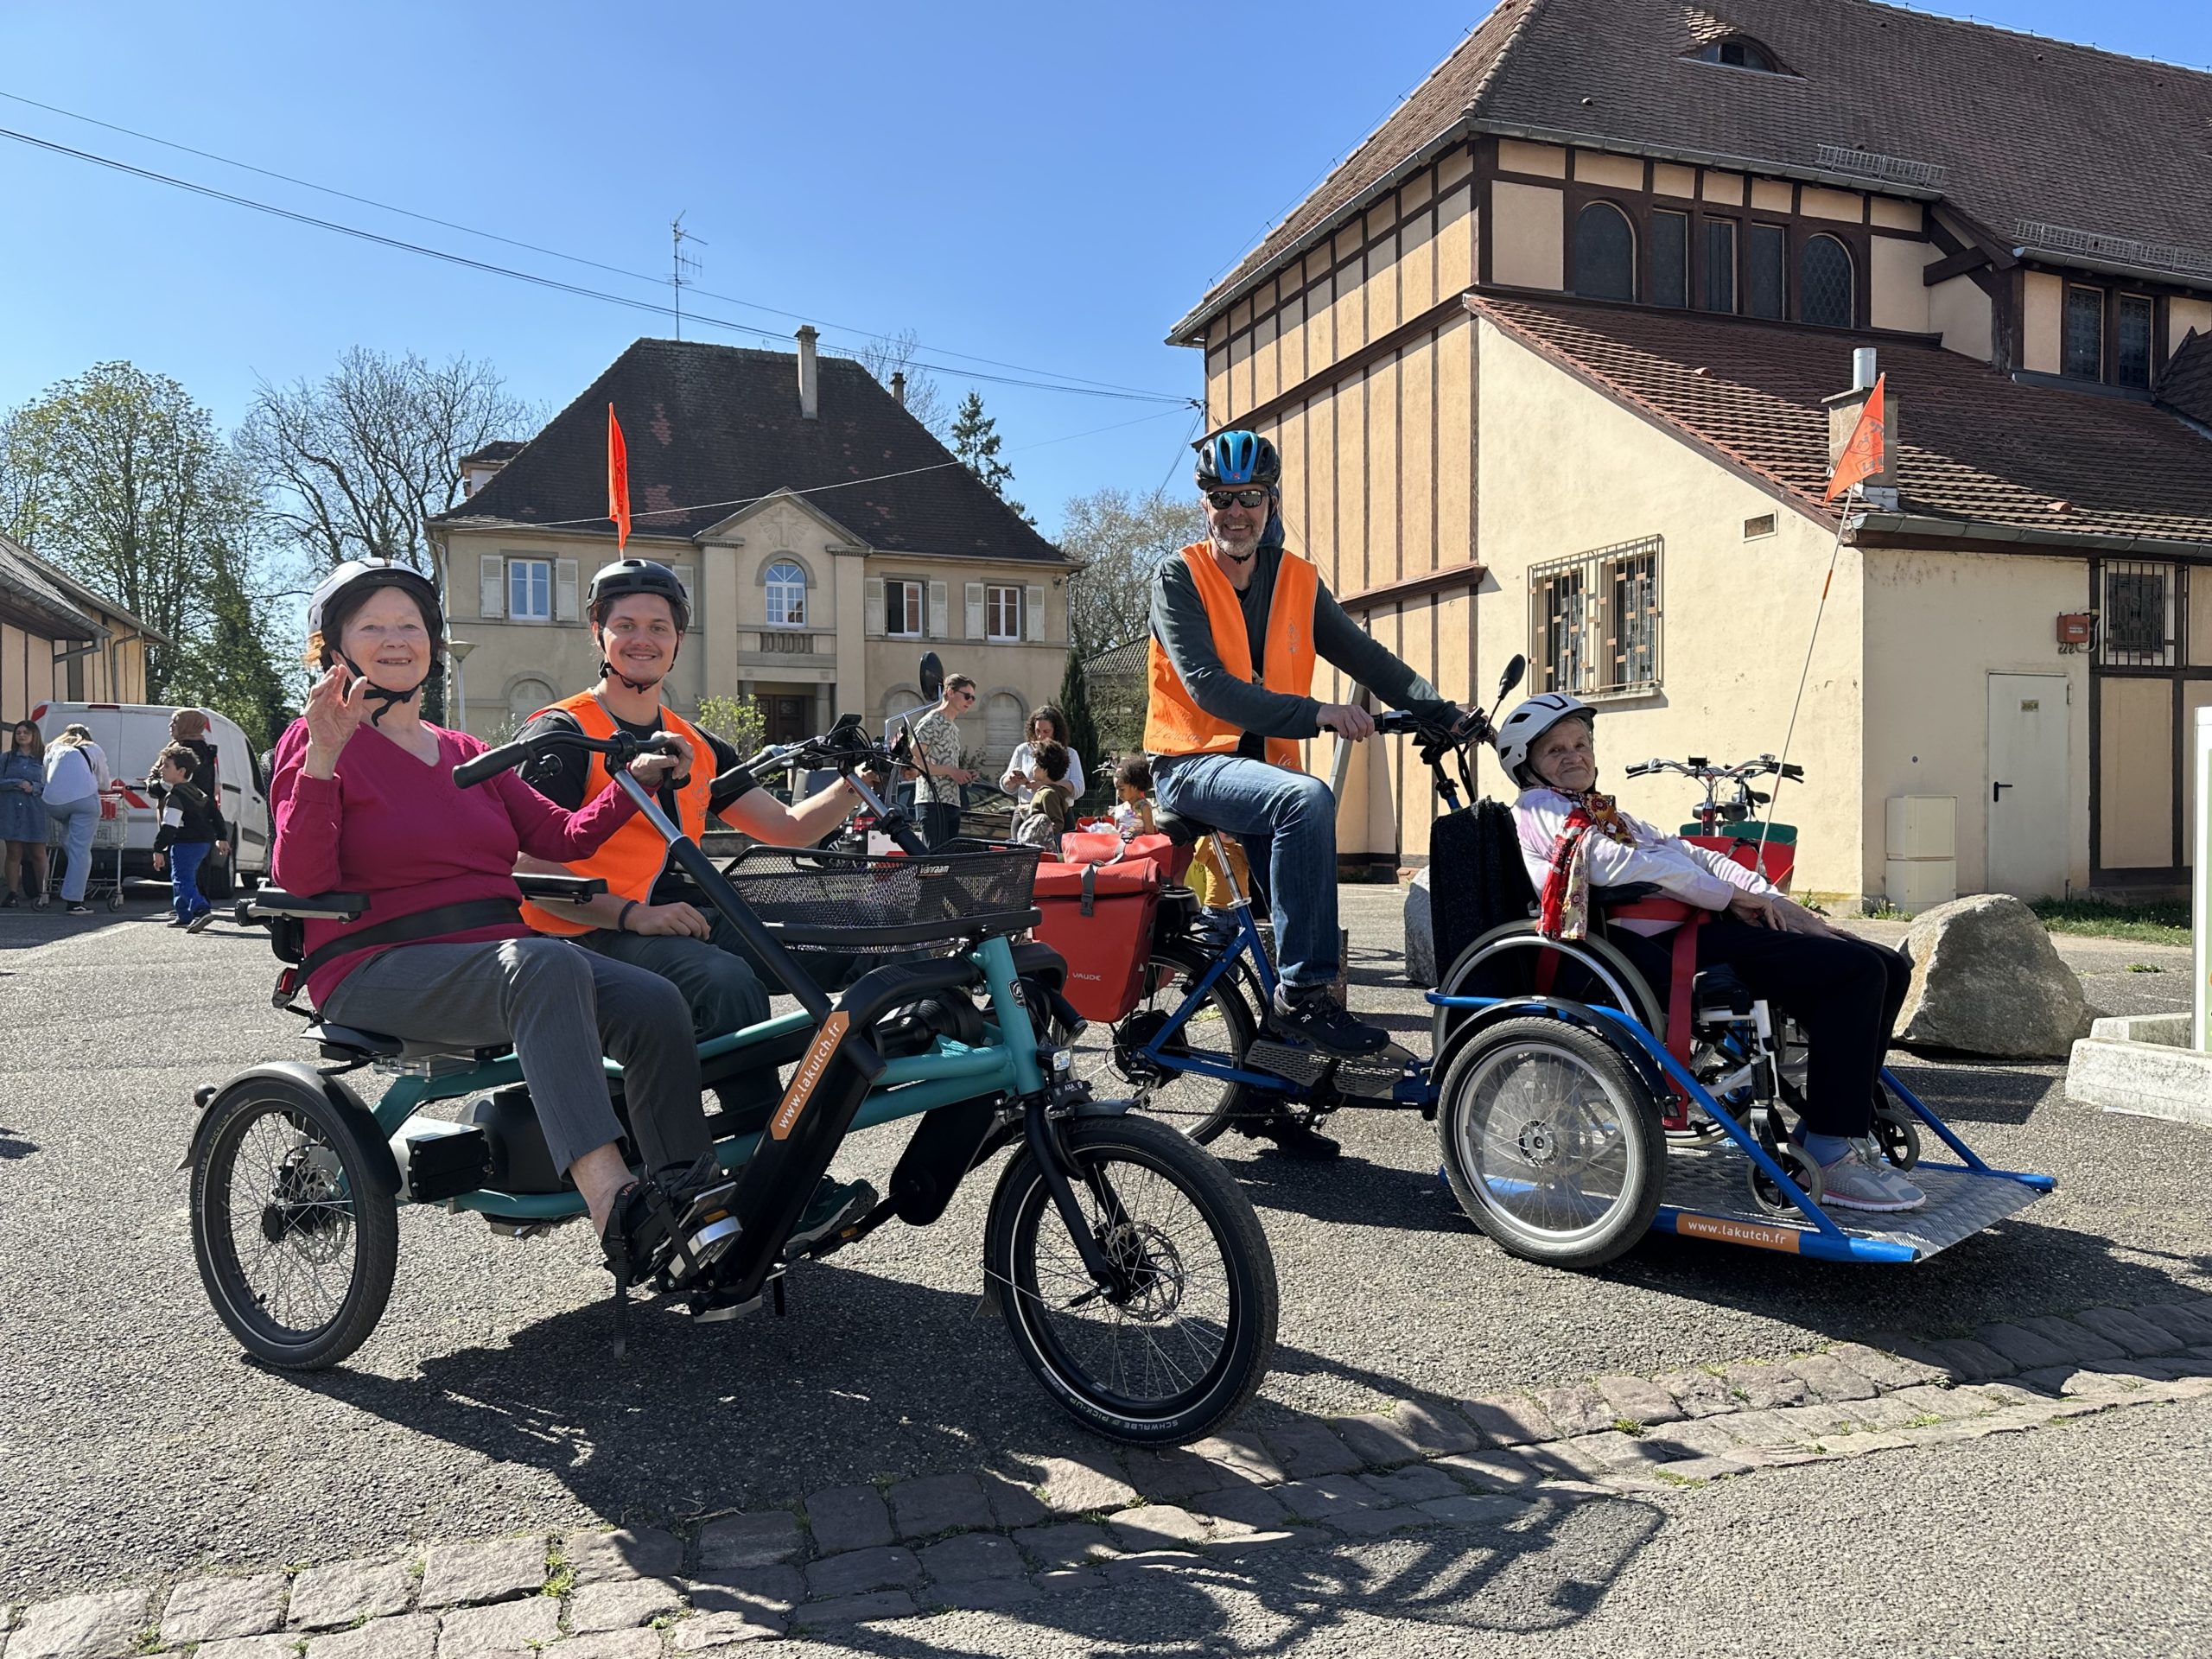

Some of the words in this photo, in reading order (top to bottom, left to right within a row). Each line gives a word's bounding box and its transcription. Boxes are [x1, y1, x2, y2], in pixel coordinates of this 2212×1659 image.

[1072, 972, 1102, 982] VAUDE
[779, 1022, 841, 1128] www.lakutch.fr
[1065, 1083, 1076, 1091] AXA
[196, 1156, 208, 1213] SCHWALBE
[209, 1114, 230, 1145] PICK-UP
[1688, 1221, 1787, 1244] www.lakutch.fr
[1070, 1396, 1109, 1422] PICK-UP
[1124, 1419, 1179, 1431] SCHWALBE
